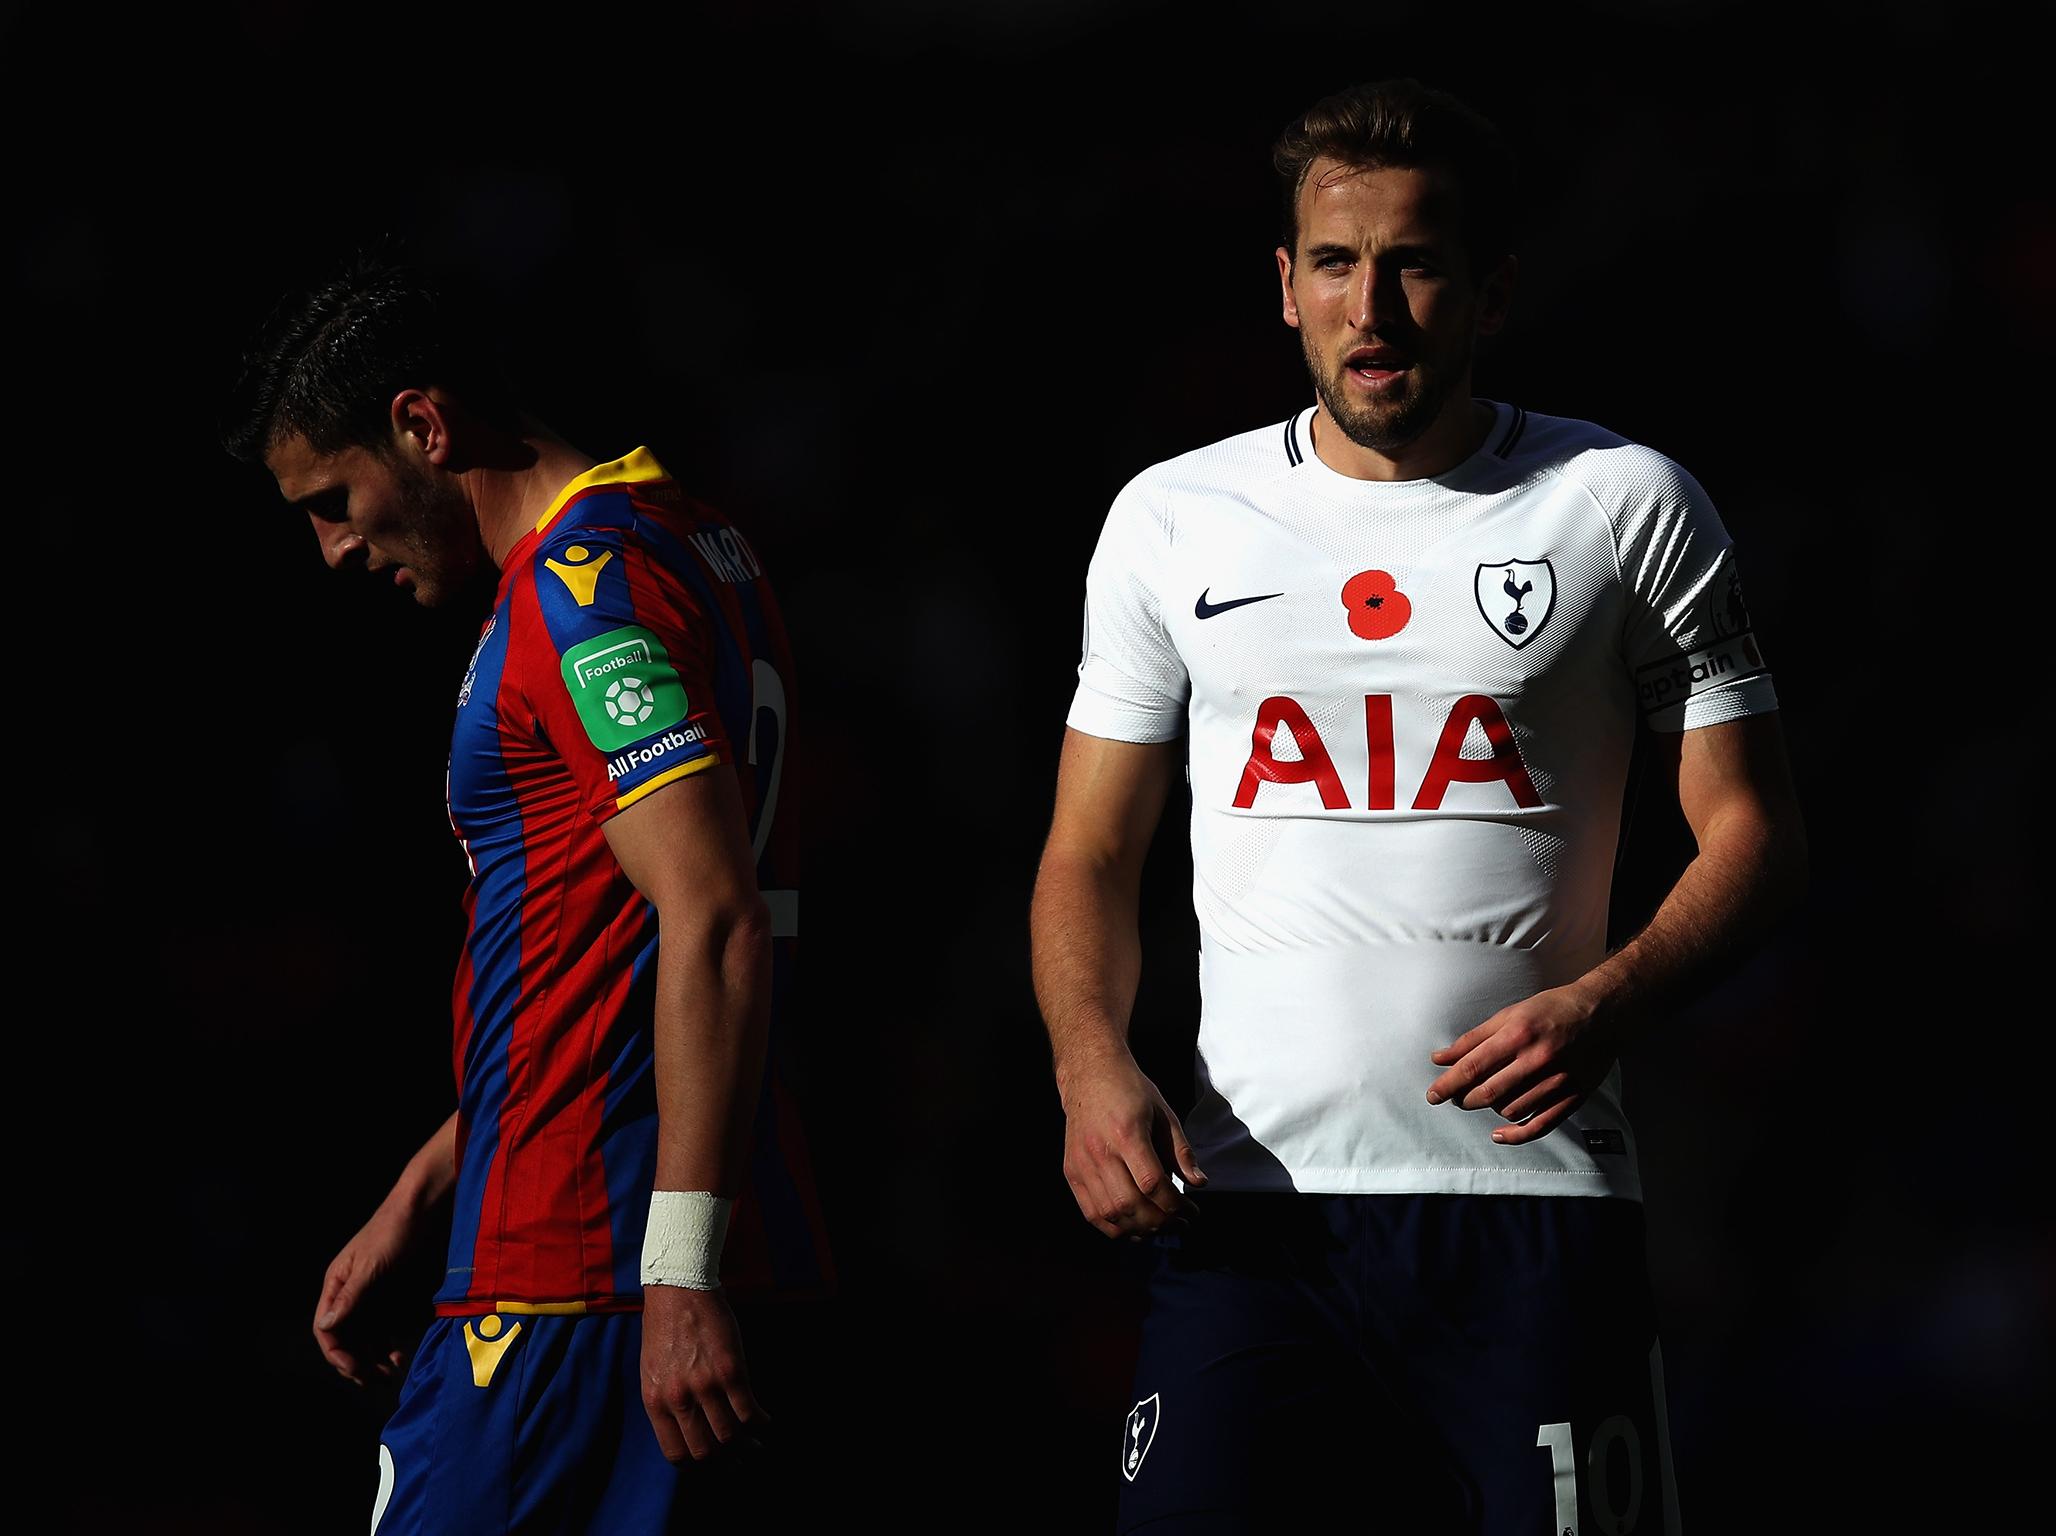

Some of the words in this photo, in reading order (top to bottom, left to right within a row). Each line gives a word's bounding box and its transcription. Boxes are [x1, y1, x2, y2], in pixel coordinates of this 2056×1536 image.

[687, 525, 761, 583] WARD
[585, 650, 642, 681] Football
[1639, 652, 1735, 702] aptain
[607, 757, 631, 782] All
[627, 722, 707, 770] Football
[1231, 693, 1546, 810] AIA
[748, 657, 800, 938] 2
[1536, 1415, 1644, 1536] 10
